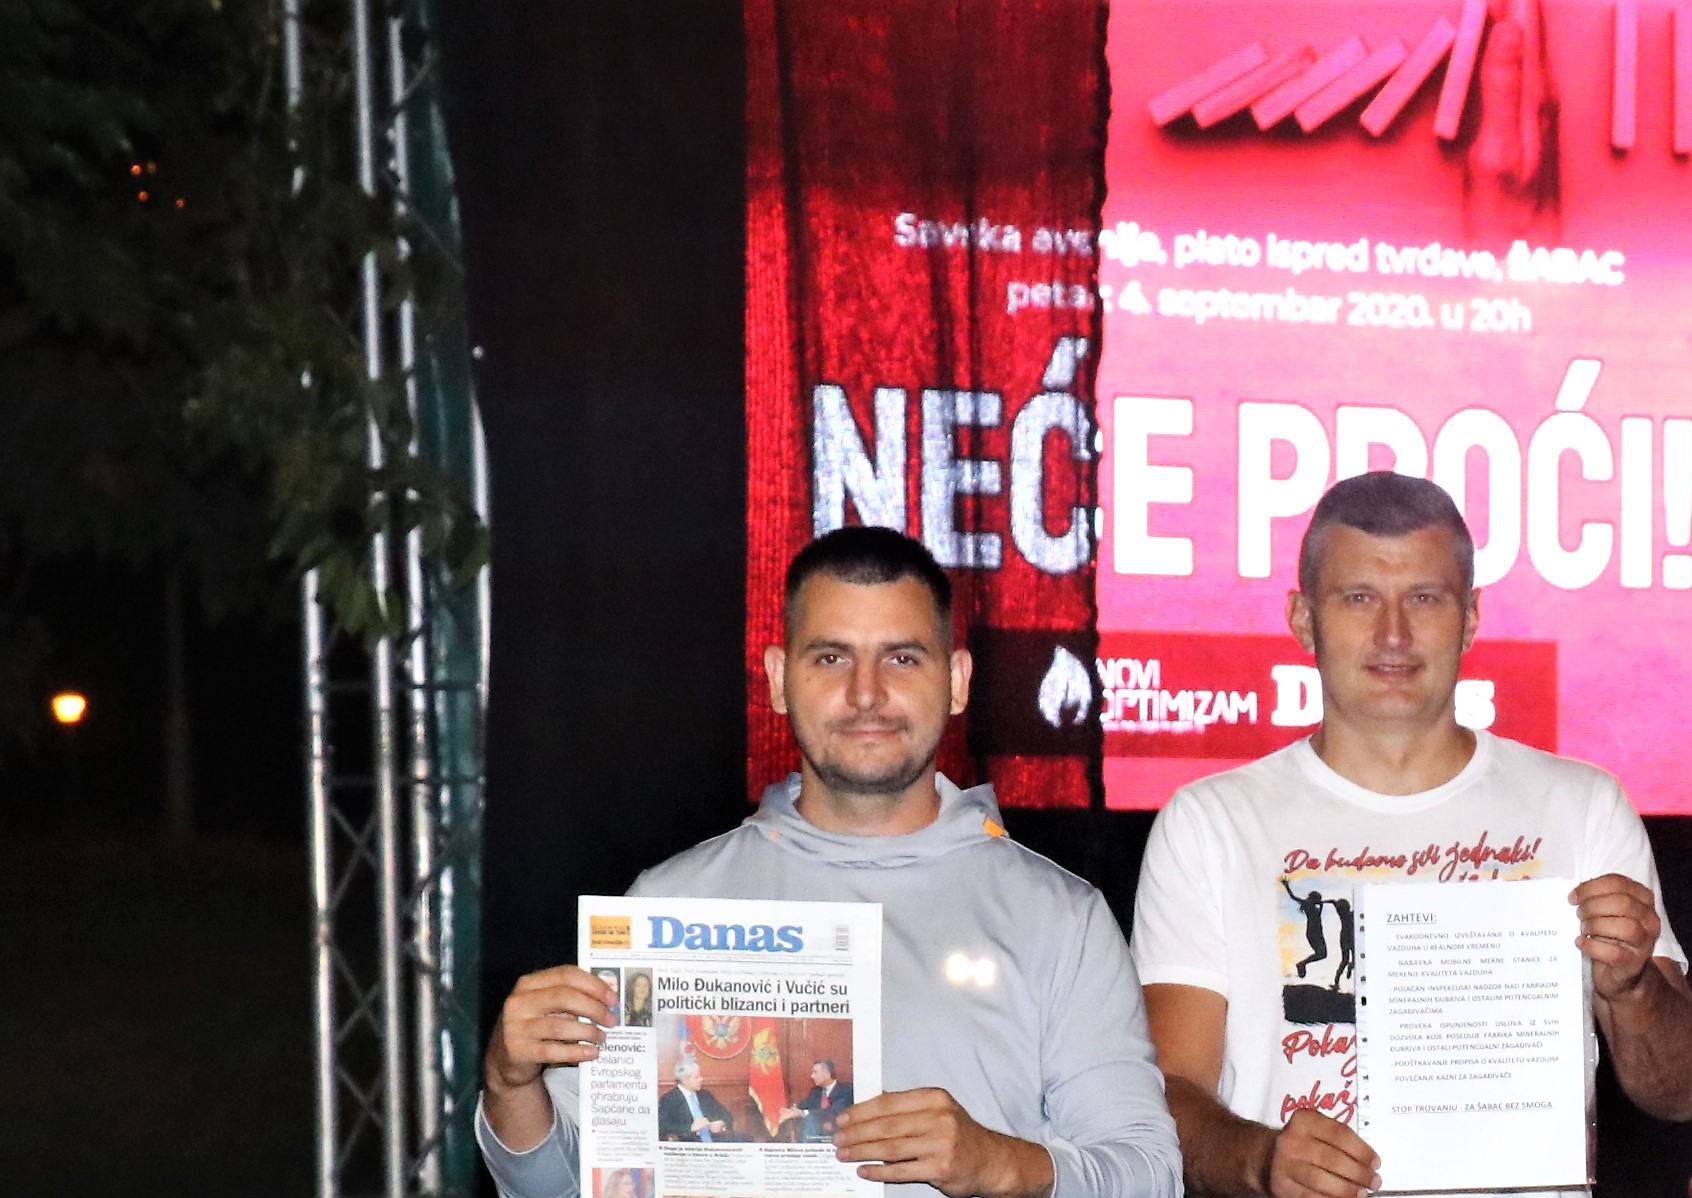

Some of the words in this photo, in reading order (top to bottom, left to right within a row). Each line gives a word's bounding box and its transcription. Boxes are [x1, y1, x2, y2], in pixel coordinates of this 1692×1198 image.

[1174, 230, 1261, 267] plato
[1267, 233, 1368, 275] ispred
[1157, 286, 1342, 325] septembar
[1347, 291, 1436, 328] 2020.
[1440, 302, 1465, 332] u
[1469, 298, 1533, 332] 20h
[811, 336, 1194, 576] NEĆE
[1095, 657, 1161, 689] NOVI
[1284, 849, 1320, 873] Da
[1324, 847, 1407, 871] budemo
[1407, 844, 1440, 875] svi
[1439, 831, 1542, 882] jednaki!
[1387, 913, 1437, 923] ZAHTEVI:
[647, 916, 804, 953] Danas
[658, 977, 689, 992] Milo
[694, 978, 773, 994] Đukanović
[777, 979, 780, 993] i
[786, 979, 825, 995] Vučić
[830, 984, 847, 995] su
[658, 996, 716, 1012] politički
[721, 996, 778, 1012] blizanci
[782, 998, 785, 1012] i
[790, 1000, 850, 1015] partneri
[595, 1043, 645, 1053] elenović:
[596, 1055, 634, 1064] oslanici
[591, 1067, 641, 1079] Evropskog
[591, 1080, 647, 1089] parlamenta
[592, 1103, 635, 1114] Šapčane
[638, 1106, 650, 1114] da
[1415, 1104, 1457, 1112] TROVANJU
[1477, 1101, 1503, 1110] ŠABAC
[1522, 1101, 1552, 1109] SMOGA
[592, 1117, 625, 1127] glasaju
